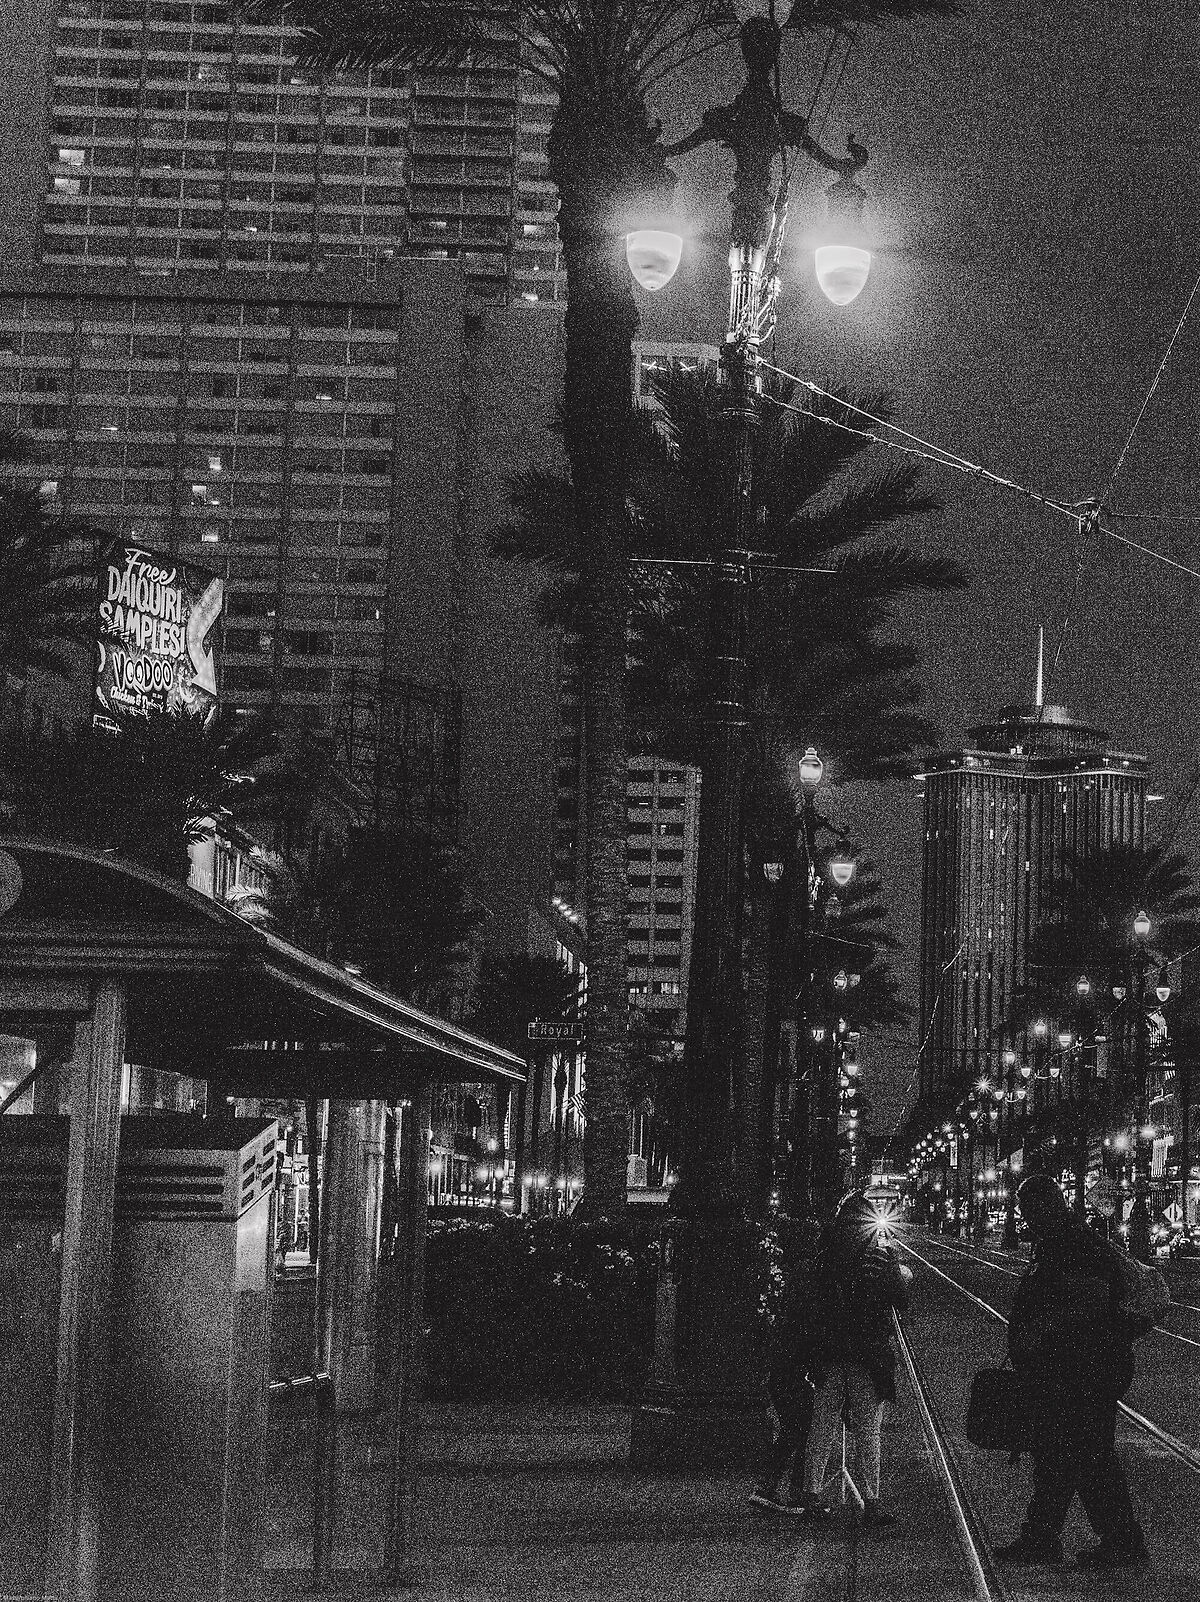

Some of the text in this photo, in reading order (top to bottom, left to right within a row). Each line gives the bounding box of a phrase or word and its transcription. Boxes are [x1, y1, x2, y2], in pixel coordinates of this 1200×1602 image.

[125, 549, 176, 585] Free
[108, 566, 182, 624] DAIQUIRI
[100, 600, 186, 660] SAMPLES!
[540, 1024, 574, 1037] Royal
